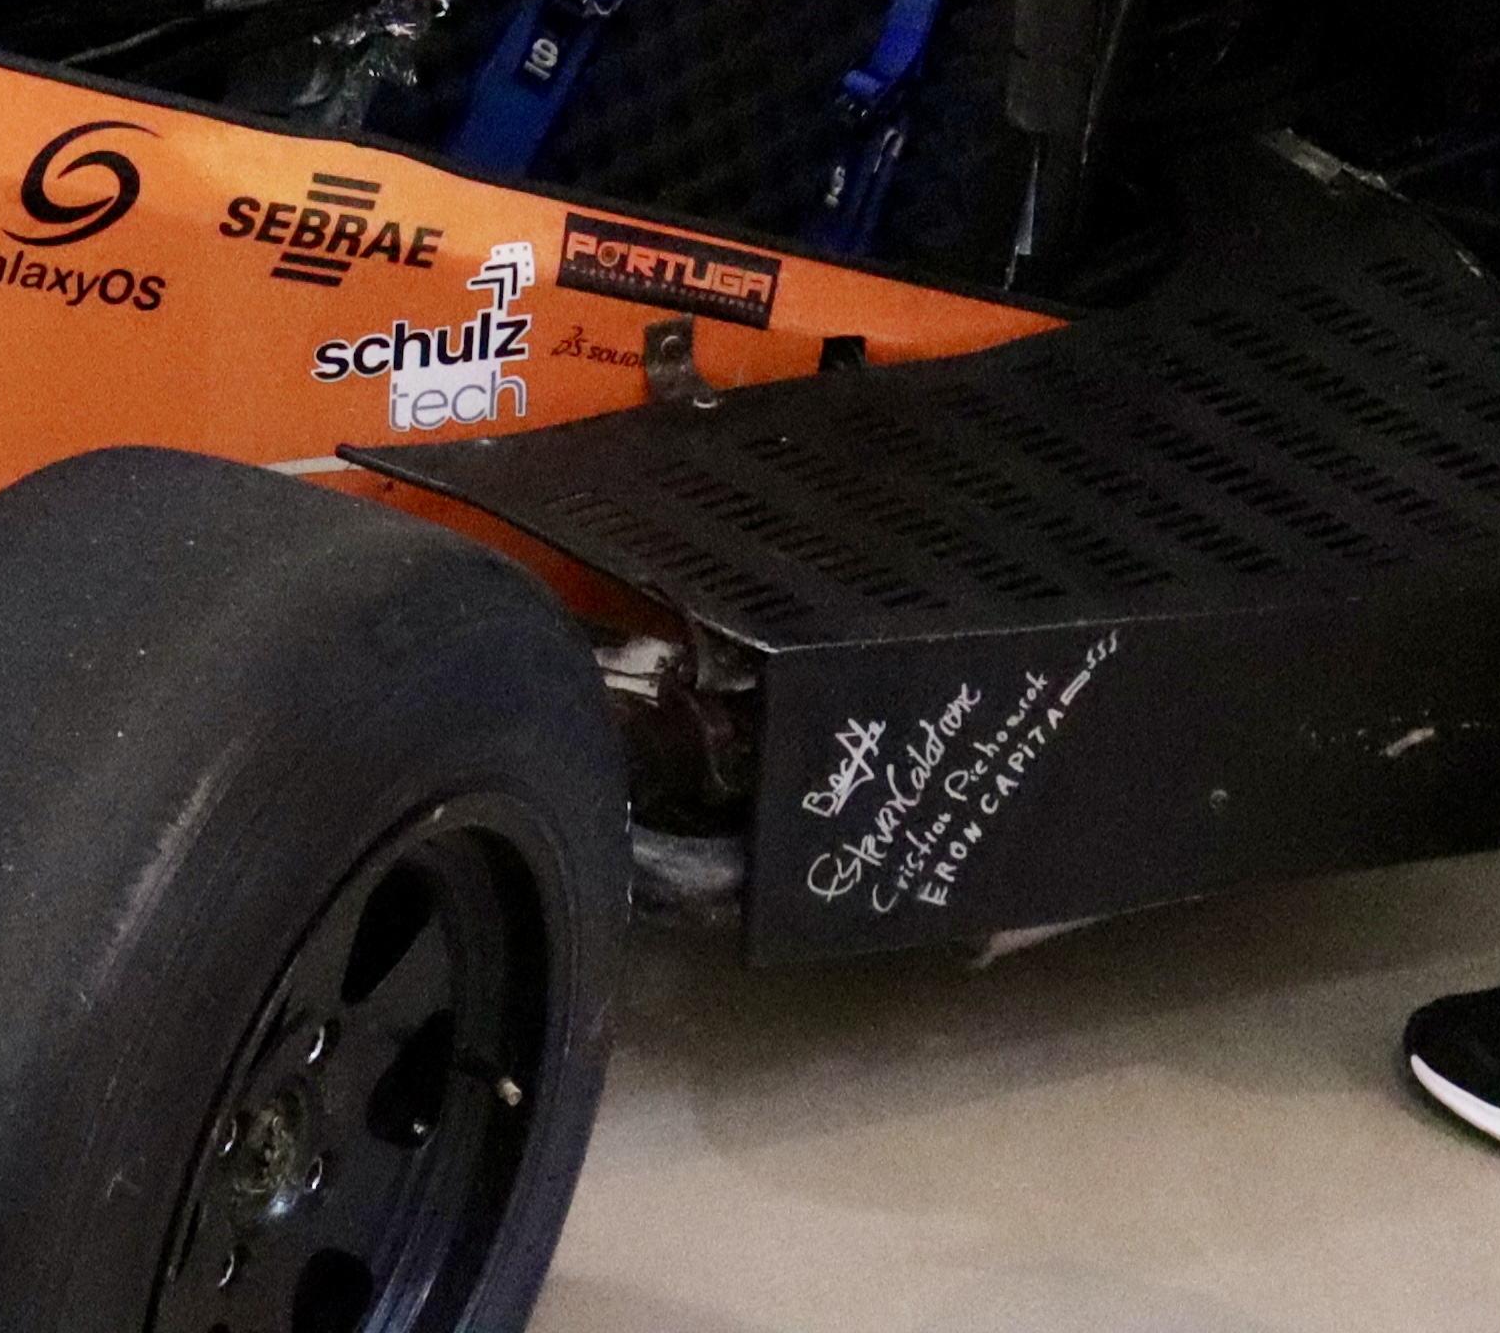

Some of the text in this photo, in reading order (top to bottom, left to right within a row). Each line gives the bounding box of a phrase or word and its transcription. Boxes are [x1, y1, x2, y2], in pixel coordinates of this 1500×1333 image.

[219, 196, 445, 269] SEBRAE
[567, 232, 774, 304] PORTUGA
[314, 312, 531, 380] schulz
[389, 372, 527, 432] tech
[920, 820, 983, 907] ERON
